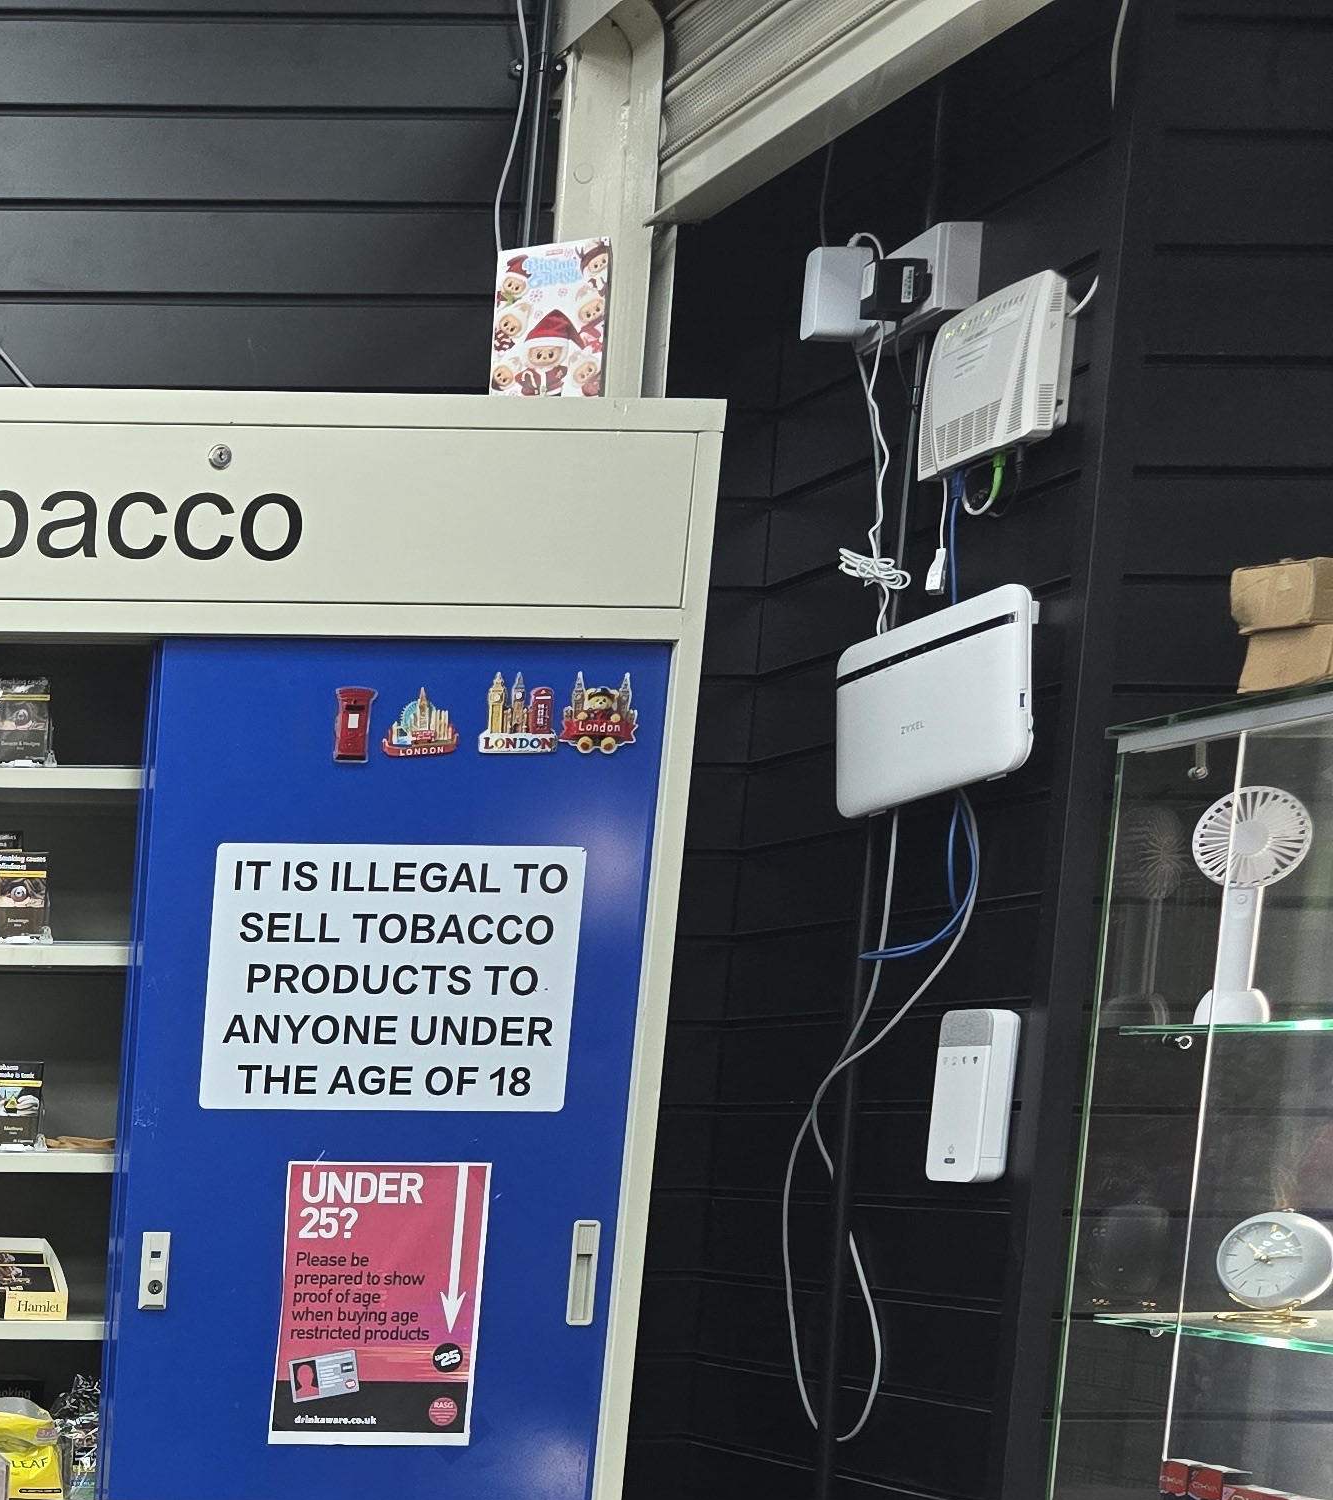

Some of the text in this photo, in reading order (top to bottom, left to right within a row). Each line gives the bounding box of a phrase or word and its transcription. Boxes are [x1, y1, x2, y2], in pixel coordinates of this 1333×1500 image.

[578, 722, 621, 733] London
[399, 746, 444, 756] LONDON
[483, 736, 554, 750] LONDON
[234, 860, 568, 894] IT IS ILLEGAL TO
[239, 912, 554, 945] SELL TOBACCO
[247, 963, 538, 995] PRODUCTS TO
[222, 1014, 553, 1046] ANYONE UNDER
[237, 1065, 531, 1096] THE AGE OF 18
[302, 1172, 423, 1204] UNDER
[299, 1208, 358, 1238] 25?
[296, 1252, 369, 1266] Please be
[294, 1272, 425, 1288] prepared to show
[293, 1290, 381, 1307] proof of age
[17, 1301, 61, 1313] Hamlet
[292, 1308, 419, 1325] when buying age
[290, 1327, 429, 1343] restricted products
[433, 1400, 453, 1409] RASG
[295, 1414, 377, 1425] drinkaware.co.uk
